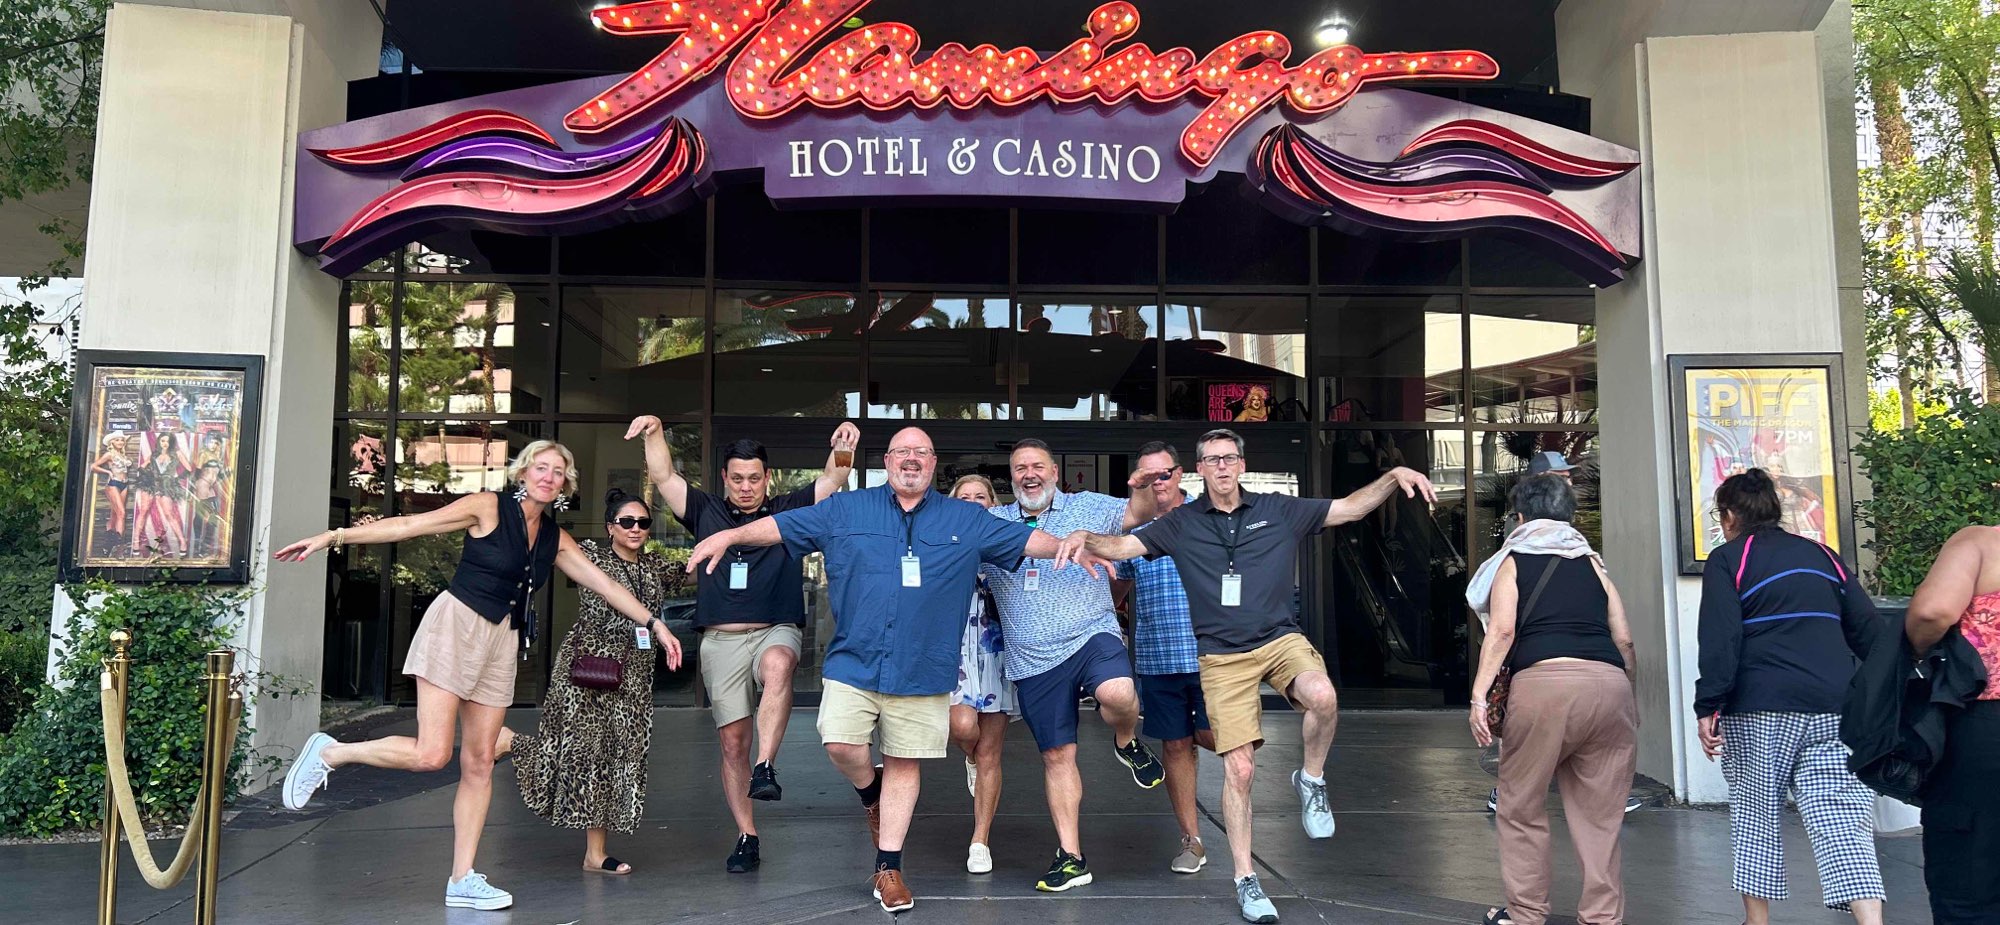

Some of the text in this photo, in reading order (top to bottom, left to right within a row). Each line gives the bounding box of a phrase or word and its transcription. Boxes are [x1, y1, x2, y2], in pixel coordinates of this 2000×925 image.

[563, 0, 1500, 168] Flamingo
[789, 137, 1162, 183] HOTEL & CASINO
[1208, 384, 1245, 398] QUEENS
[1208, 397, 1227, 410] ARE
[1709, 384, 1812, 417] PIFF
[1208, 409, 1233, 422] WILD
[1711, 419, 1732, 428] THE
[1734, 419, 1767, 428] MAGIC
[1774, 430, 1813, 444] 7PM
